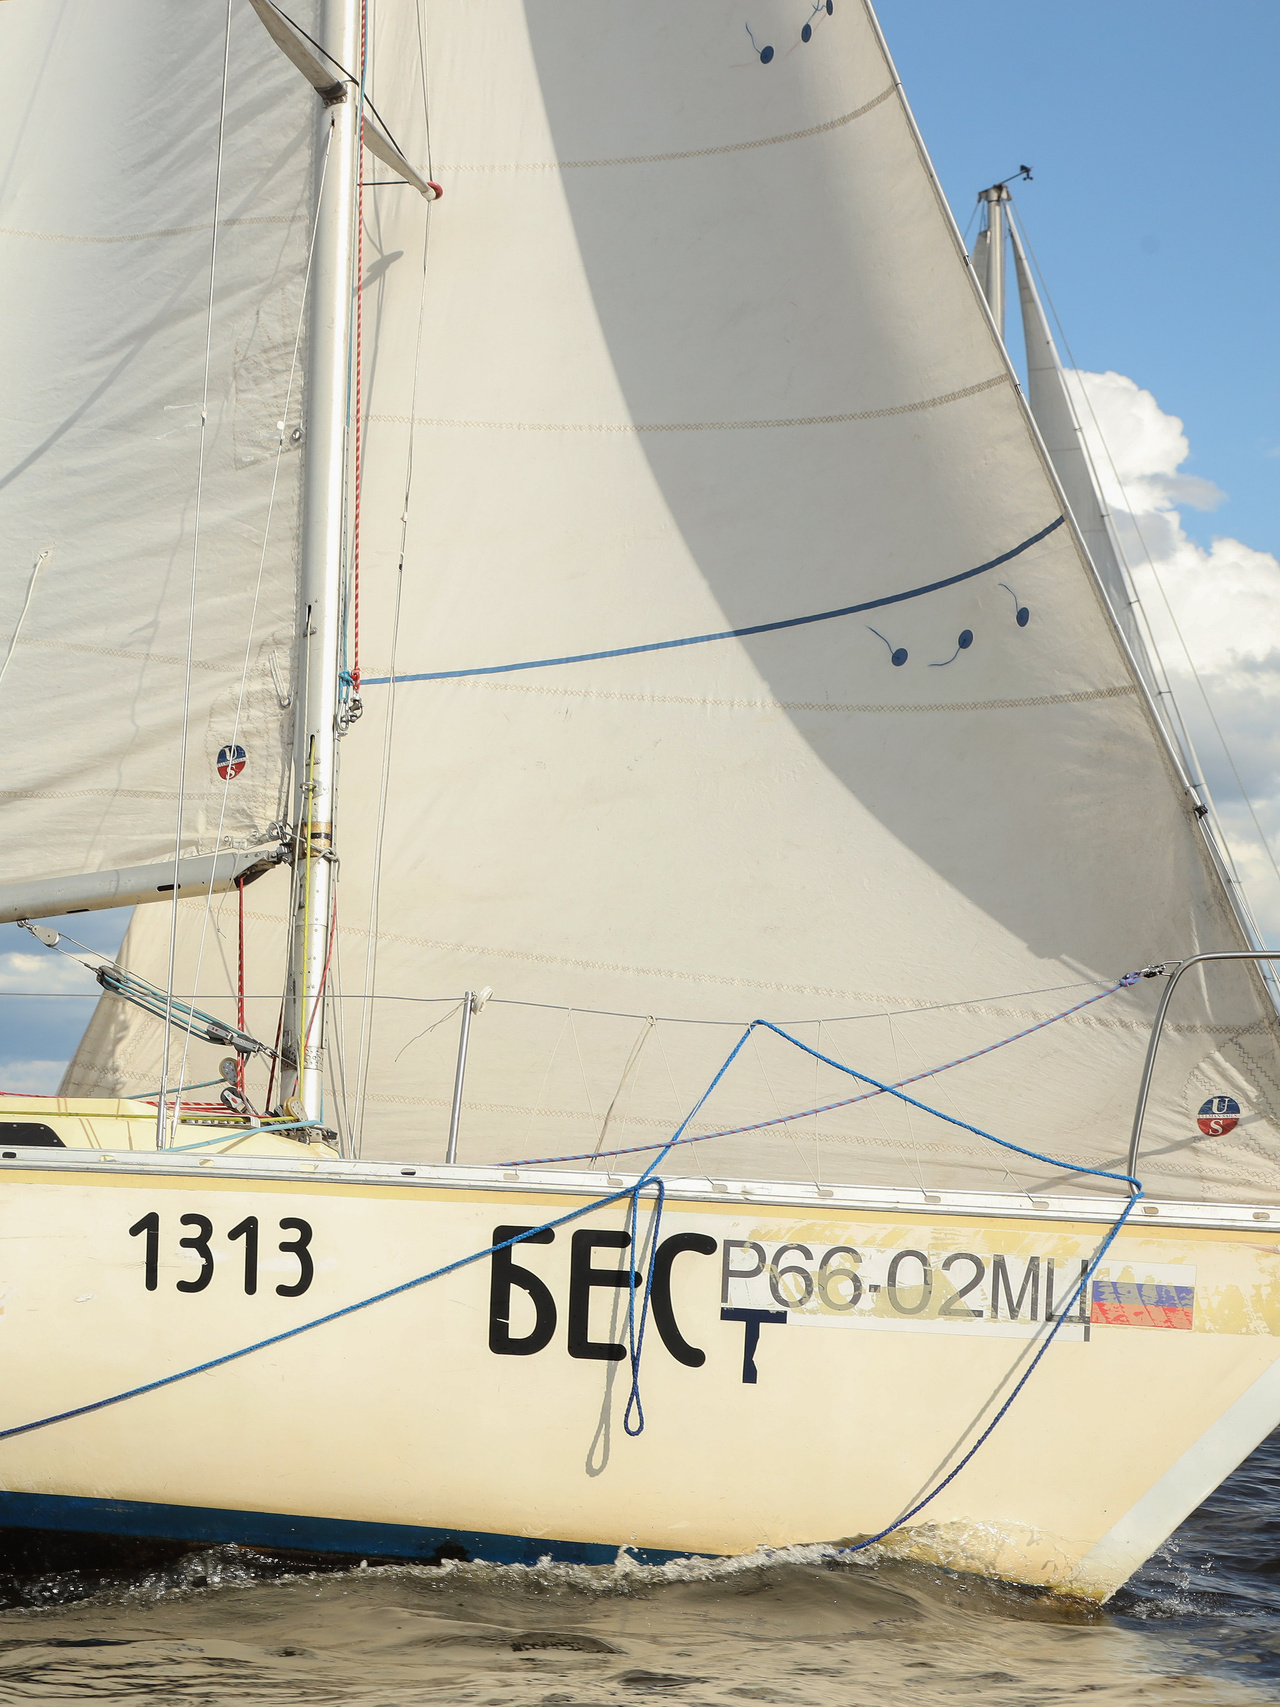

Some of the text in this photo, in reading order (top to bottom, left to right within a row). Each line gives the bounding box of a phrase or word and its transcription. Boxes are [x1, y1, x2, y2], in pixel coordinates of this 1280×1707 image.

[1211, 1097, 1231, 1114] U
[1208, 1119, 1224, 1136] S
[128, 1211, 314, 1298] 1313
